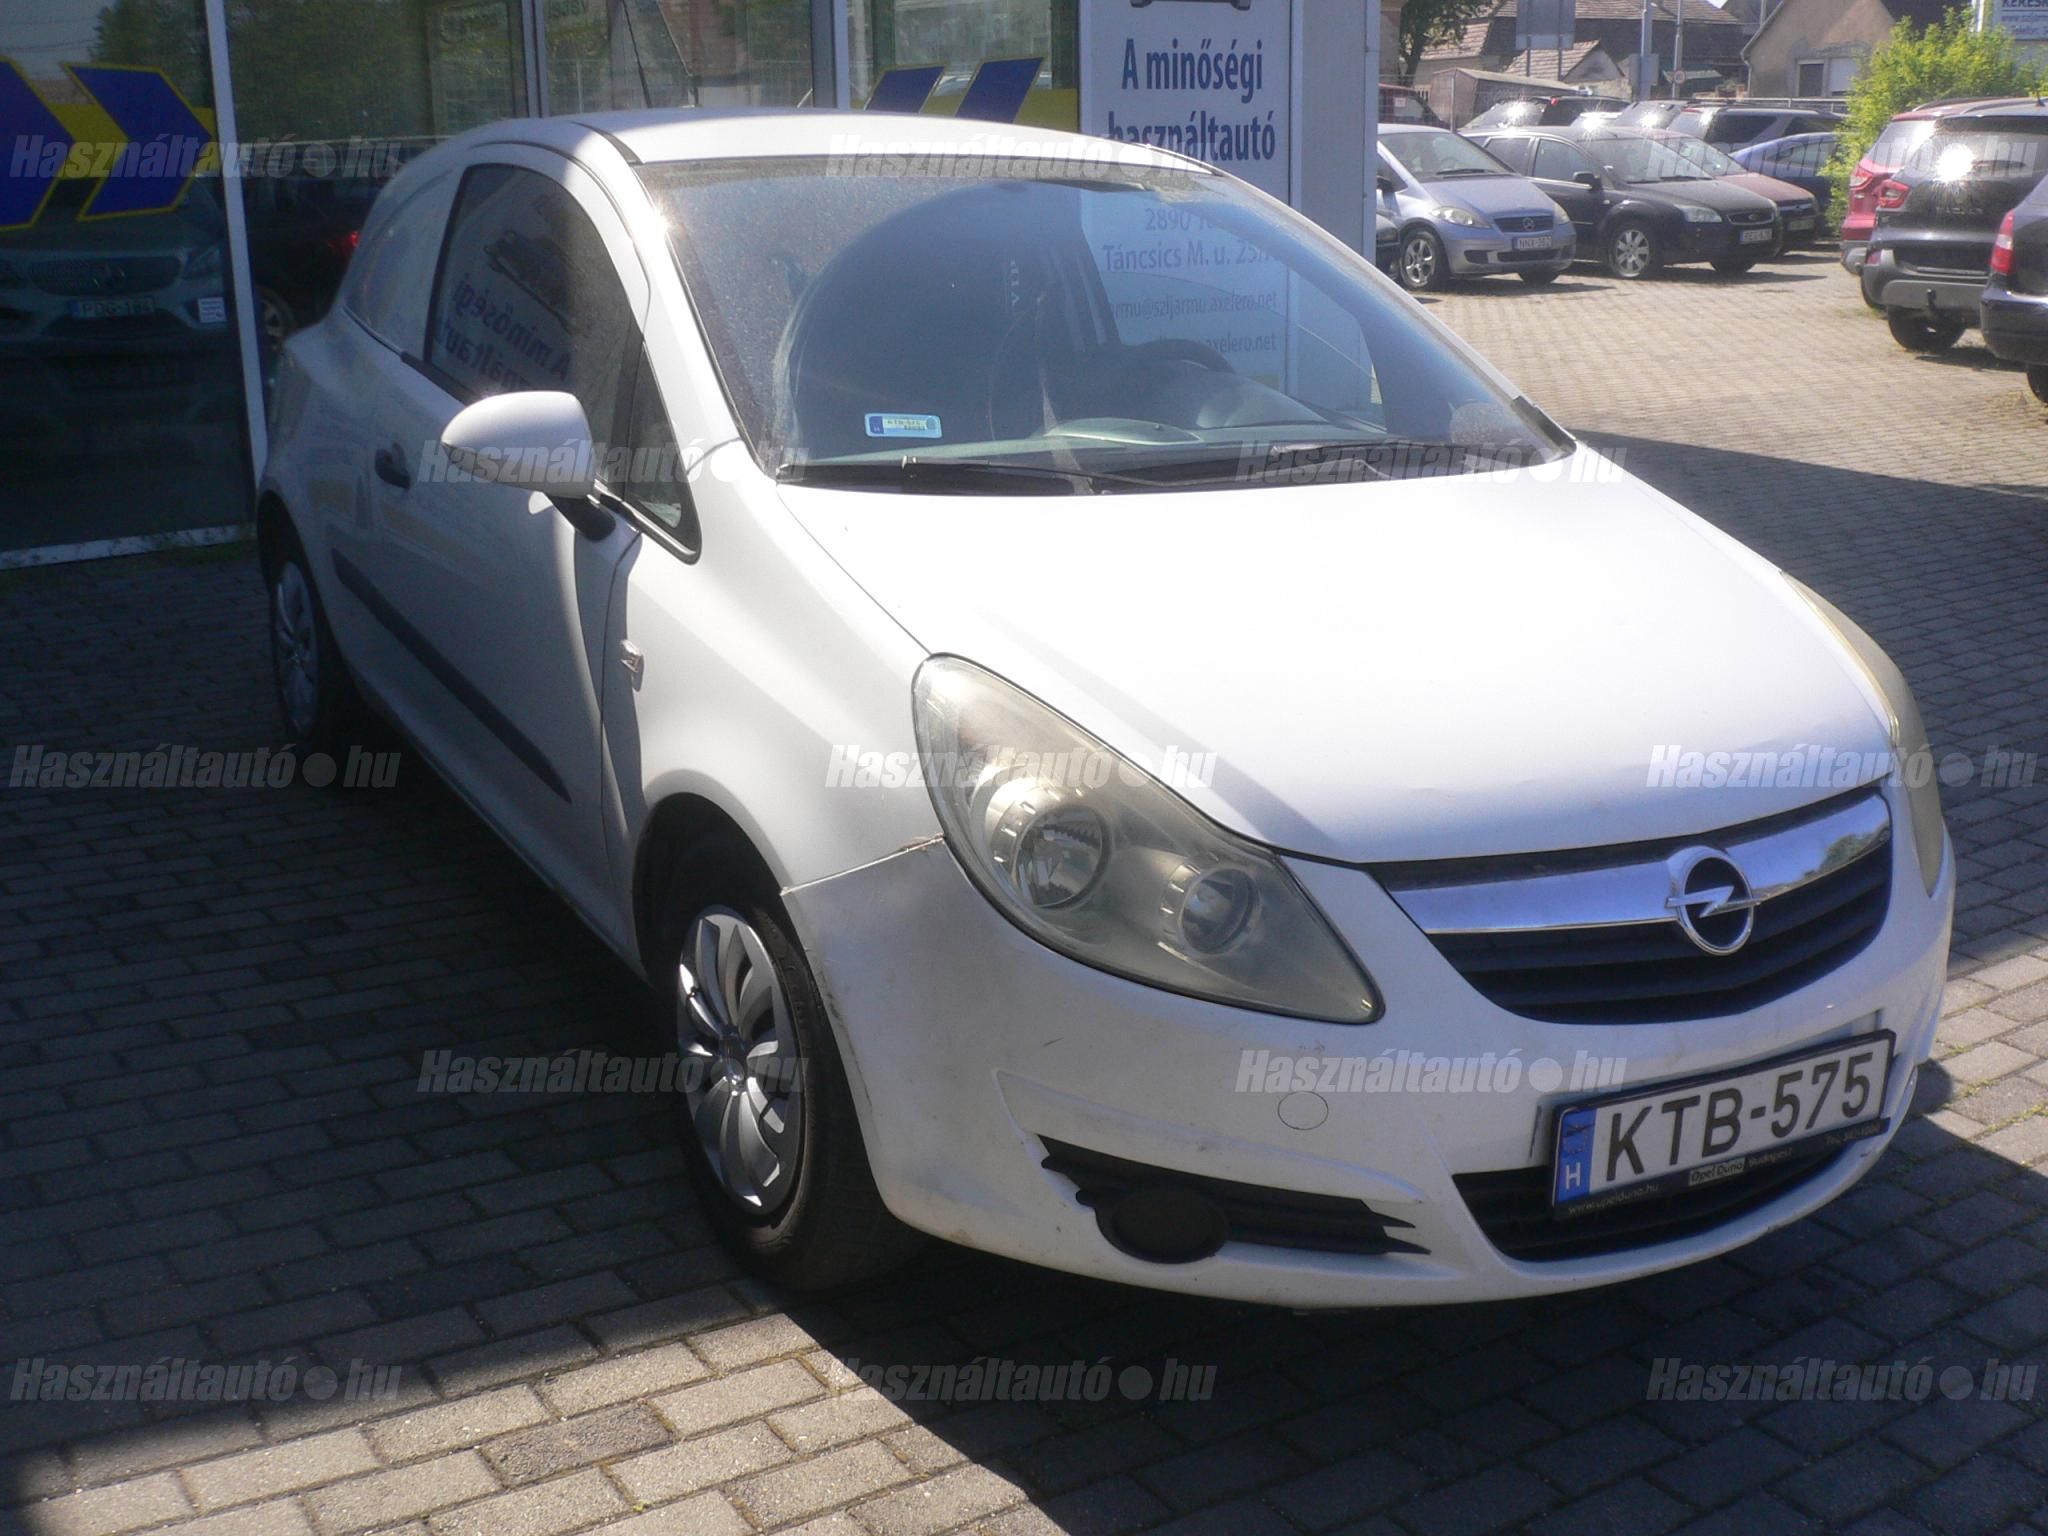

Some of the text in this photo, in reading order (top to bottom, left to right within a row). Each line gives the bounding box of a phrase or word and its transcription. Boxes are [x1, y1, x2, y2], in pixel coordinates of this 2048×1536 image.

[1121, 38, 1263, 104] A minőségi
[1103, 243, 1182, 271] Táncsics
[1187, 240, 1209, 267] M.
[1214, 244, 1231, 265] u.
[1565, 1052, 1873, 1190] H KTB-575
